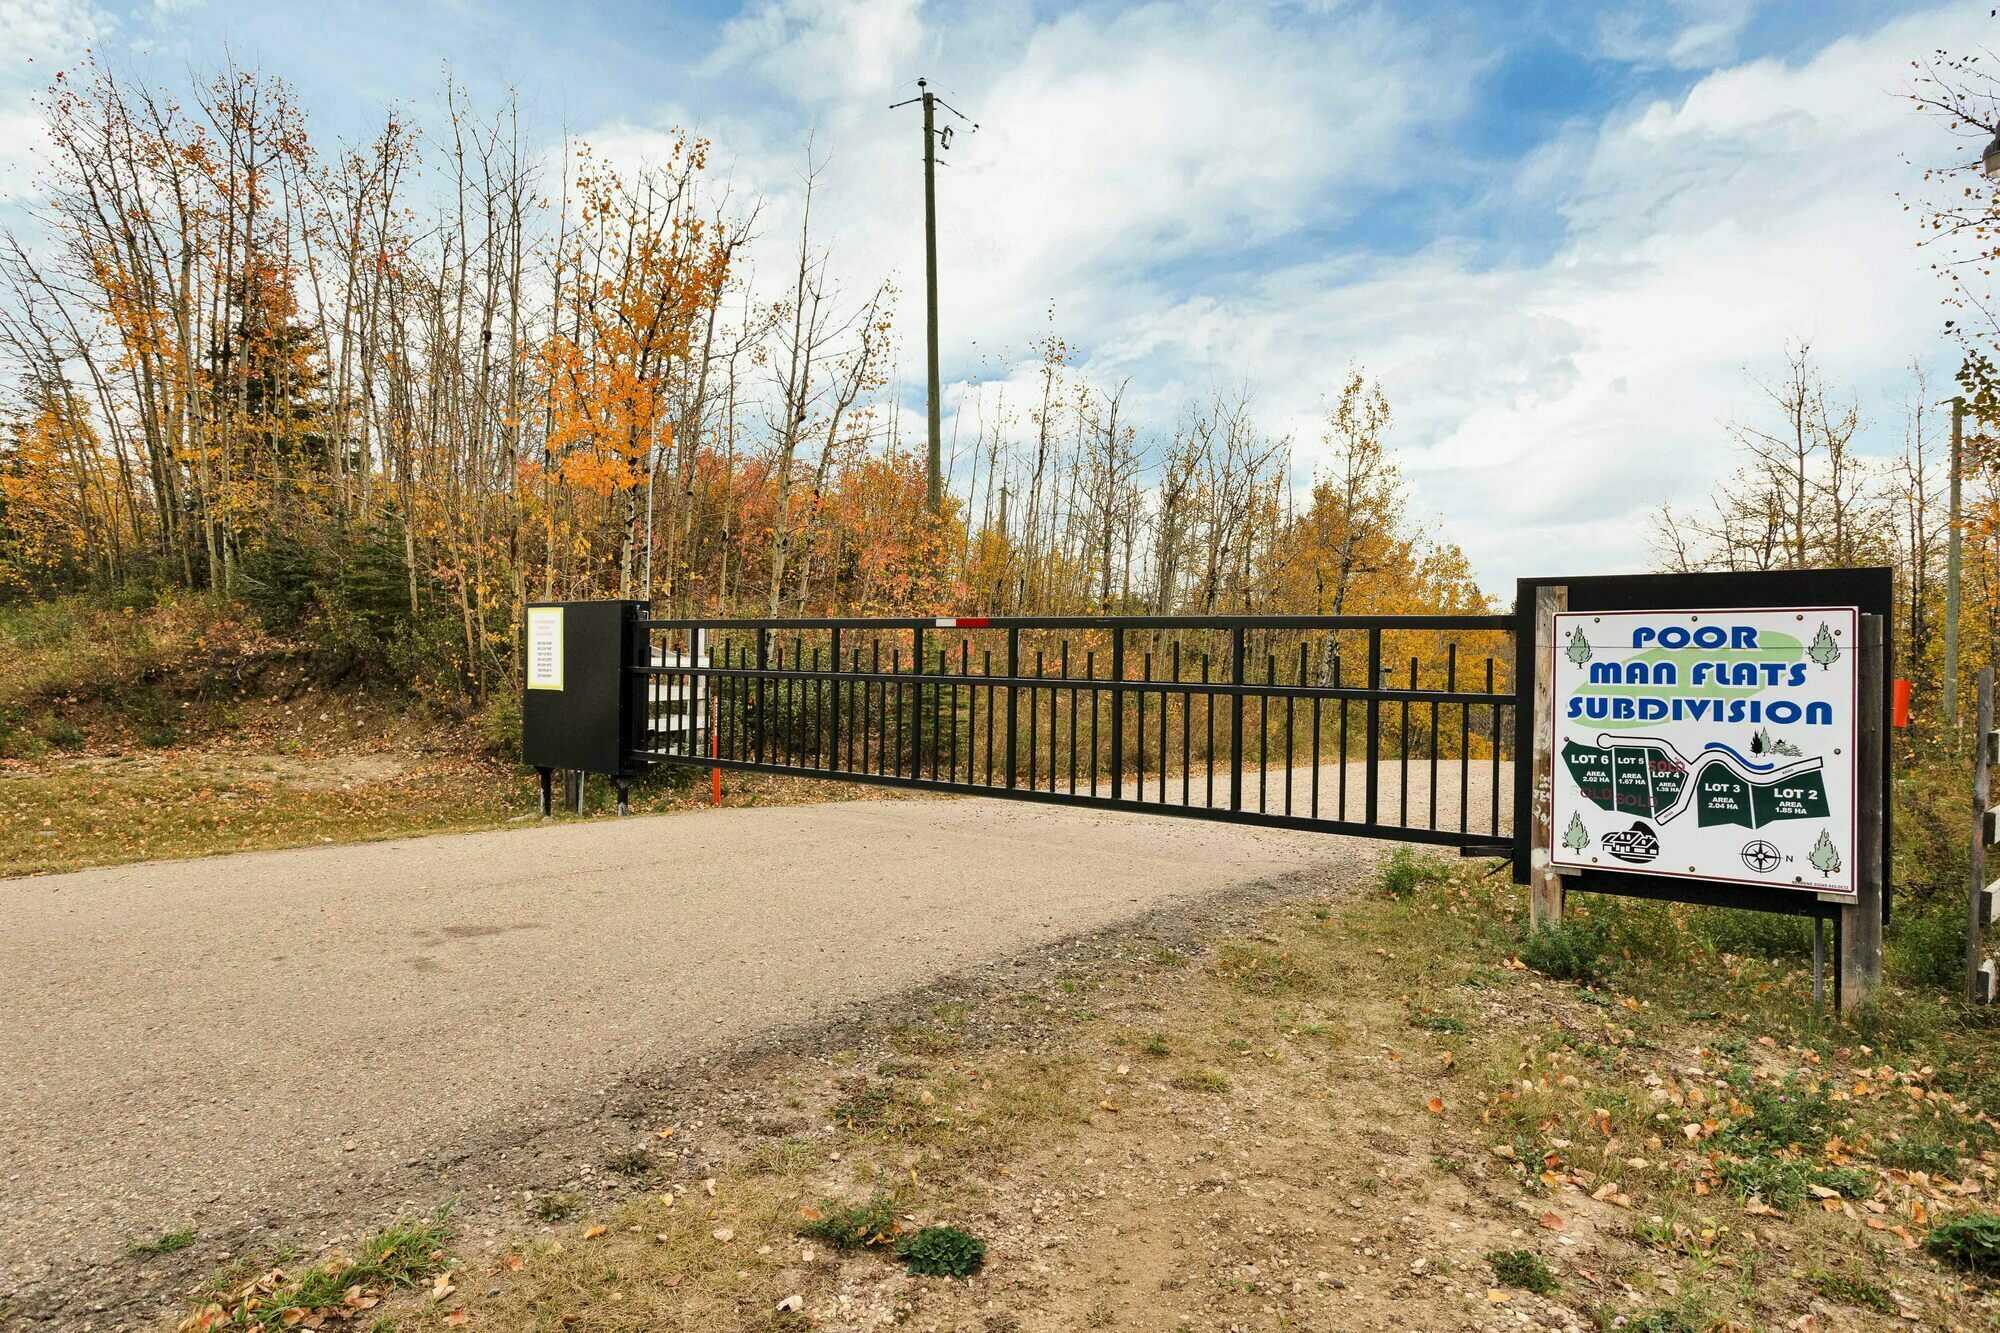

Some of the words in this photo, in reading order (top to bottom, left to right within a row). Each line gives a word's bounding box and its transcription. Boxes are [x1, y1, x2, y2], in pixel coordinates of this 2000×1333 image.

[1633, 626, 1760, 649] POOR
[1590, 662, 1676, 685] MAN
[1692, 662, 1807, 687] FLATS
[1567, 697, 1833, 725] SUBDIVISION
[1571, 755, 1596, 764] LOT
[1601, 755, 1609, 764] 6
[1648, 760, 1685, 772] SOLD
[1705, 783, 1729, 792] LOT
[1733, 784, 1741, 793] 3
[1774, 788, 1804, 799] LOT
[1808, 789, 1818, 800] 2
